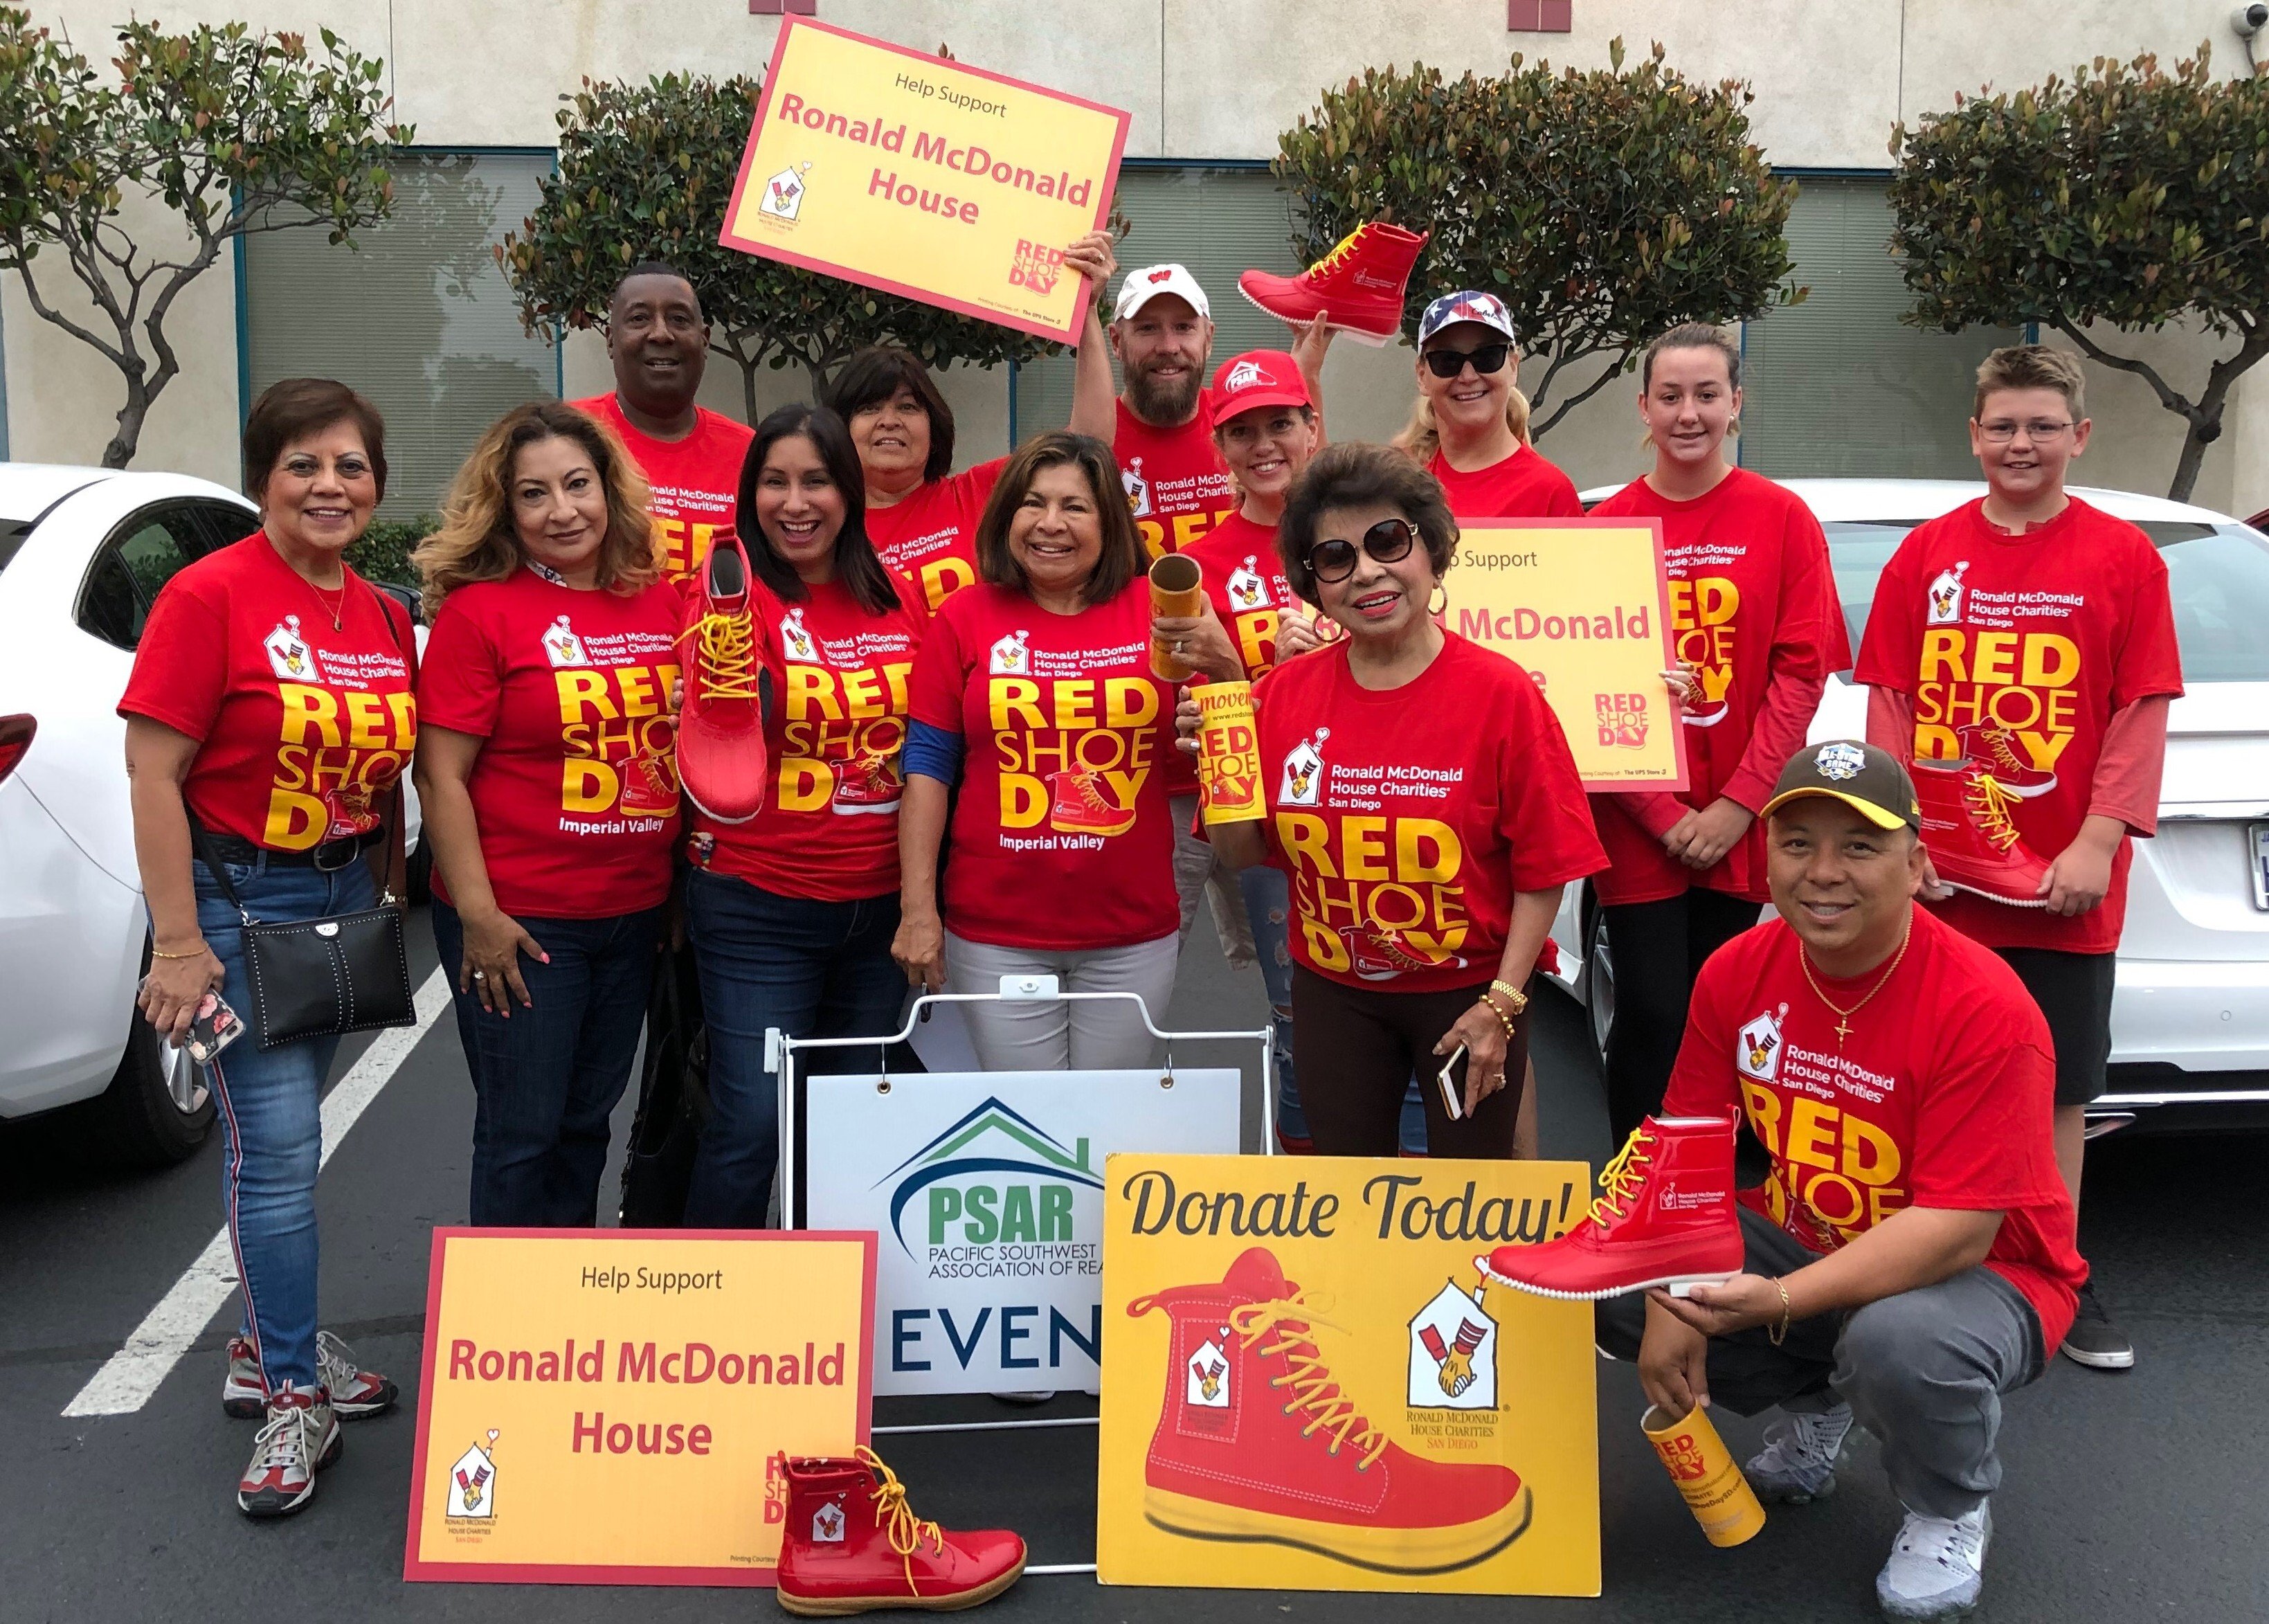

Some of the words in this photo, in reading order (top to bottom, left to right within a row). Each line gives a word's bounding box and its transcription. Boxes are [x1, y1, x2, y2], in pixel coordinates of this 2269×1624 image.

[895, 73, 935, 98] Help
[939, 85, 1007, 118] Support
[778, 93, 907, 154] Ronald
[912, 132, 1092, 208] McDonald
[868, 168, 980, 225] House
[1015, 238, 1064, 267] RED
[1013, 255, 1062, 279] SHOE
[1009, 267, 1059, 295] DY
[1155, 476, 1195, 491] Ronald
[1197, 473, 1230, 485] McDo
[676, 498, 727, 512] Charities
[679, 488, 735, 503] McDonald
[1158, 491, 1194, 503] House
[655, 506, 679, 516] Diego
[1176, 503, 1200, 511] Diego
[902, 526, 959, 551] McDonald
[900, 539, 952, 561] Charities
[1693, 544, 1746, 555] McDonald
[1465, 549, 1538, 571] Support
[1971, 589, 2015, 603] Ronald
[2018, 590, 2083, 606] McDonald
[1969, 602, 2009, 615] House
[2012, 604, 2069, 617] Charities
[1458, 606, 1650, 640] McDonald
[1967, 616, 1985, 625] San
[1987, 618, 2014, 628] Diego
[584, 633, 626, 646] Ronald
[625, 632, 675, 642] McDonald
[820, 636, 856, 649] onald
[317, 649, 358, 665] Ronald
[358, 652, 406, 668] McDnald
[588, 647, 627, 657] House
[627, 642, 673, 653] Charities
[856, 642, 907, 657] Charities
[1034, 648, 1081, 659] Ronald
[1083, 642, 1146, 658] McDonald
[1919, 629, 2081, 687] RED
[322, 662, 359, 678] House
[611, 657, 636, 665] Diego
[838, 660, 865, 669] Diego
[1034, 659, 1076, 669] House
[1081, 655, 1136, 669] Charities
[327, 676, 345, 686] San
[345, 678, 368, 689] Diego
[989, 677, 1159, 730] RED
[1594, 694, 1647, 712] RED
[1916, 682, 2077, 733] SHOE
[278, 683, 417, 750] RED
[1597, 712, 1649, 727] SHOE
[1598, 727, 1649, 748] DY
[995, 728, 1158, 773] SHOE
[1915, 724, 2074, 773] DY
[1332, 764, 1384, 779] Ronald
[1386, 766, 1463, 782] McDonald
[1825, 759, 1854, 770] GAME
[1000, 768, 1150, 829] DY
[1330, 781, 1382, 796] House
[1380, 782, 1447, 798] Charities
[1328, 797, 1348, 809] San
[1350, 798, 1381, 811] Diego
[559, 817, 626, 836] Imperial
[628, 818, 665, 835] Valley
[1000, 833, 1057, 853] Imperial
[1059, 835, 1105, 851] Valley
[1276, 812, 1462, 884] RED
[1296, 871, 1470, 931] SHOE
[1299, 912, 1470, 973] DY
[1787, 1045, 1838, 1070] Ronald
[1784, 1061, 1829, 1084] House
[1782, 1076, 1804, 1091] San
[1805, 1081, 1836, 1099] Diego
[1739, 1076, 1901, 1186] RED
[928, 1184, 1074, 1245] PSAR
[1123, 1171, 1339, 1238] Donate
[1363, 1175, 1575, 1245] Today!
[928, 1247, 994, 1262] PACIFIC
[999, 1244, 1096, 1261] SOUTHWEST
[928, 1261, 1044, 1279] ASSOCIATION
[1049, 1261, 1074, 1277] OF
[581, 1266, 631, 1294] Help
[635, 1267, 723, 1294] Support
[449, 1339, 605, 1382] Ronald
[617, 1342, 845, 1385] McDonald
[572, 1411, 712, 1454] House
[730, 1554, 752, 1564] Printing
[752, 1555, 776, 1564] Courtesy
